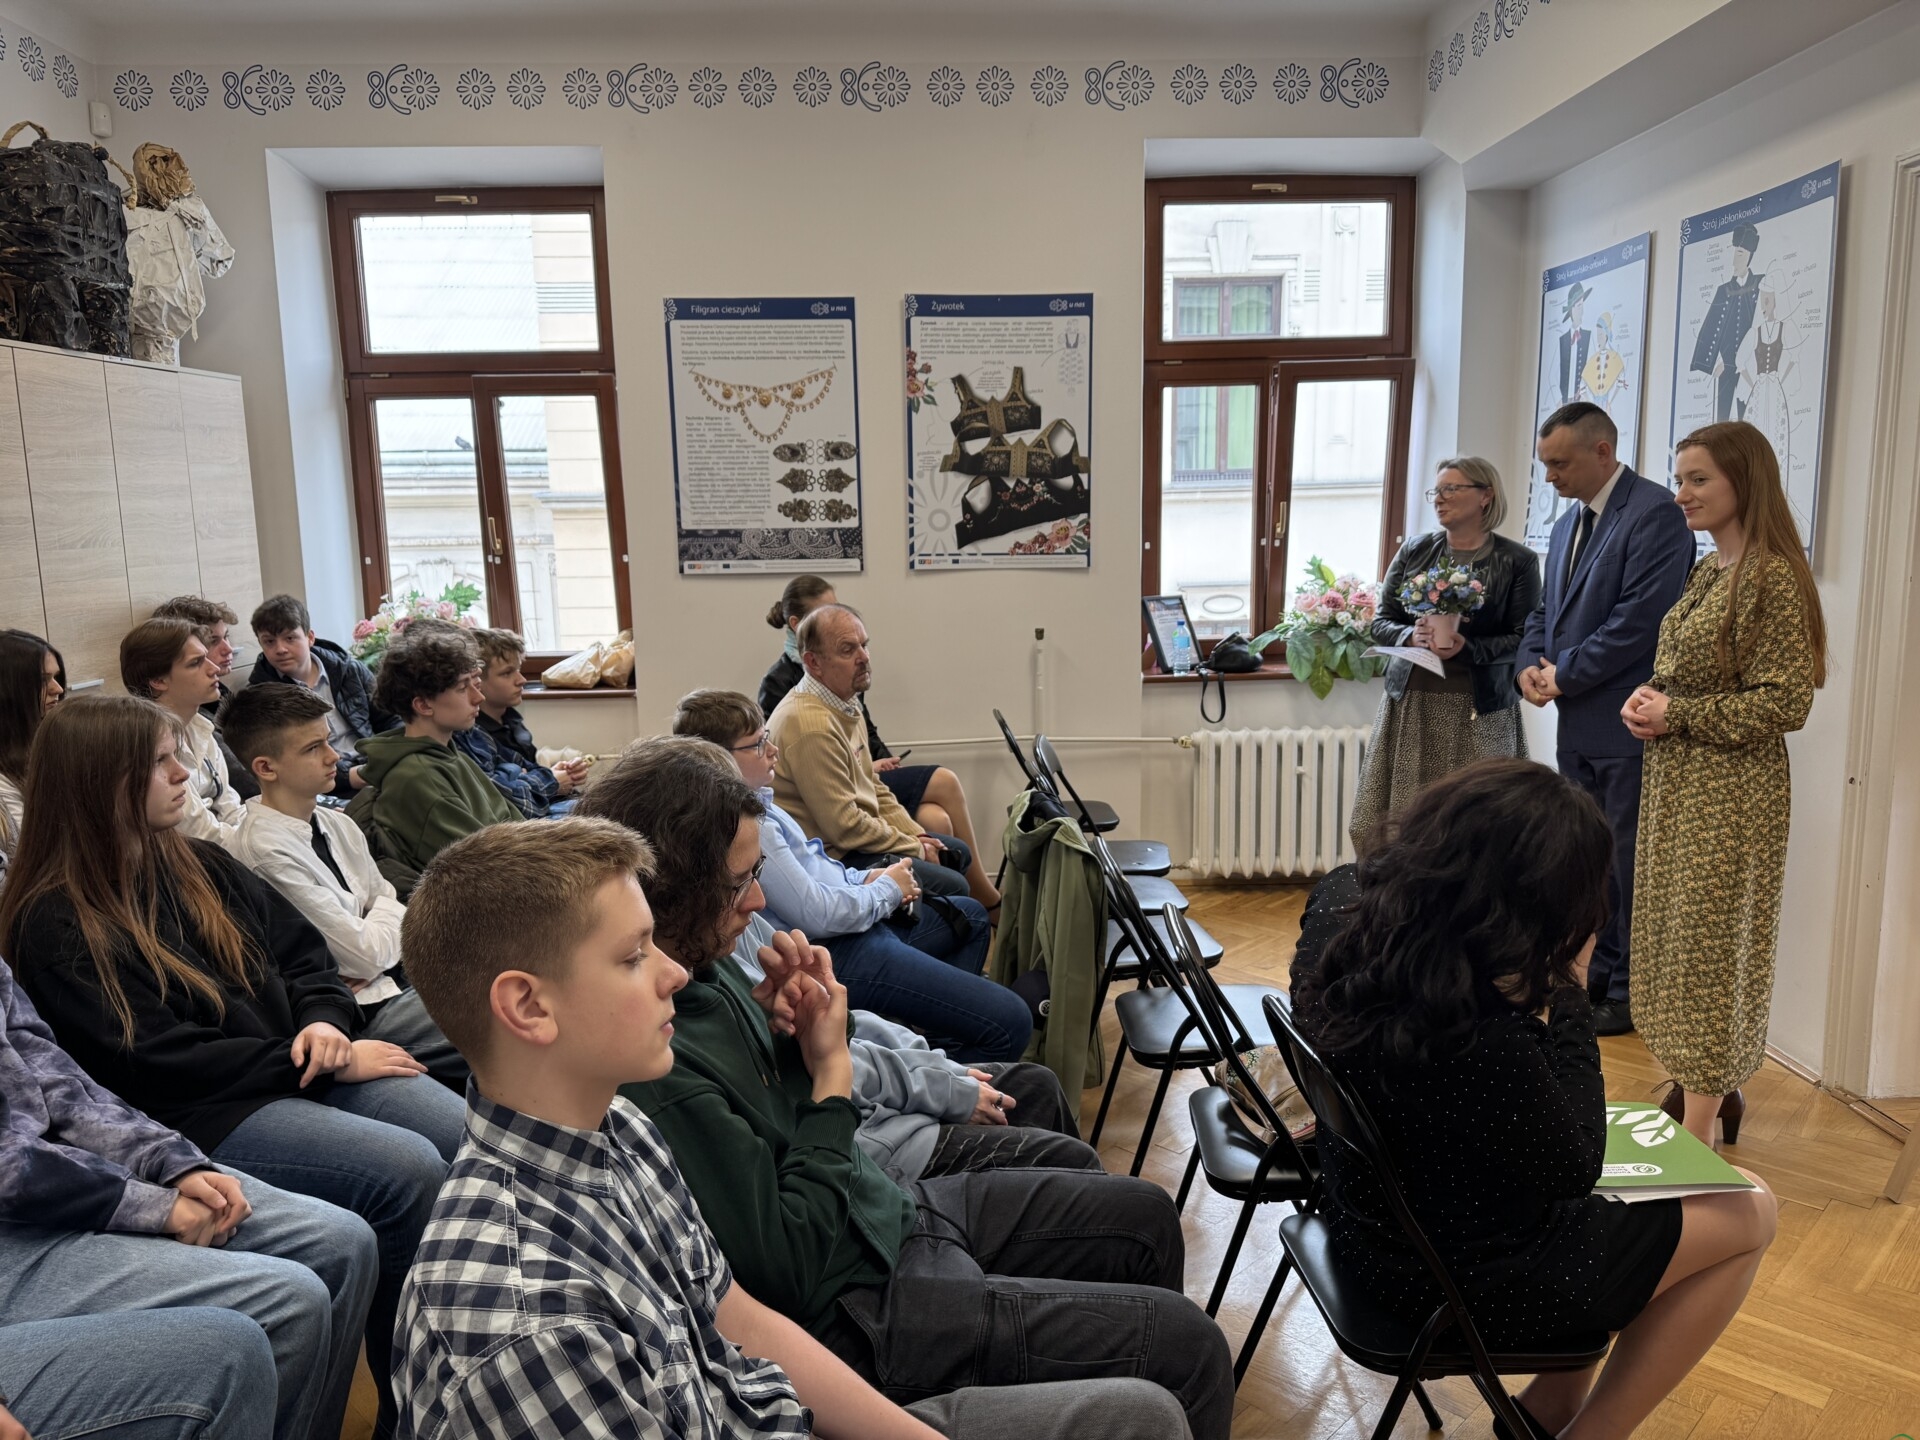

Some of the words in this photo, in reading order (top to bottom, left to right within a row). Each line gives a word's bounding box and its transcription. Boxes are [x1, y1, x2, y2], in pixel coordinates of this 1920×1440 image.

[1702, 219, 1717, 232] Strój
[1718, 203, 1761, 229] jabłonkowski
[1556, 273, 1566, 282] Strój
[691, 304, 720, 316] Filigran
[721, 304, 761, 316] cieszyński
[931, 300, 965, 312] Żywotek
